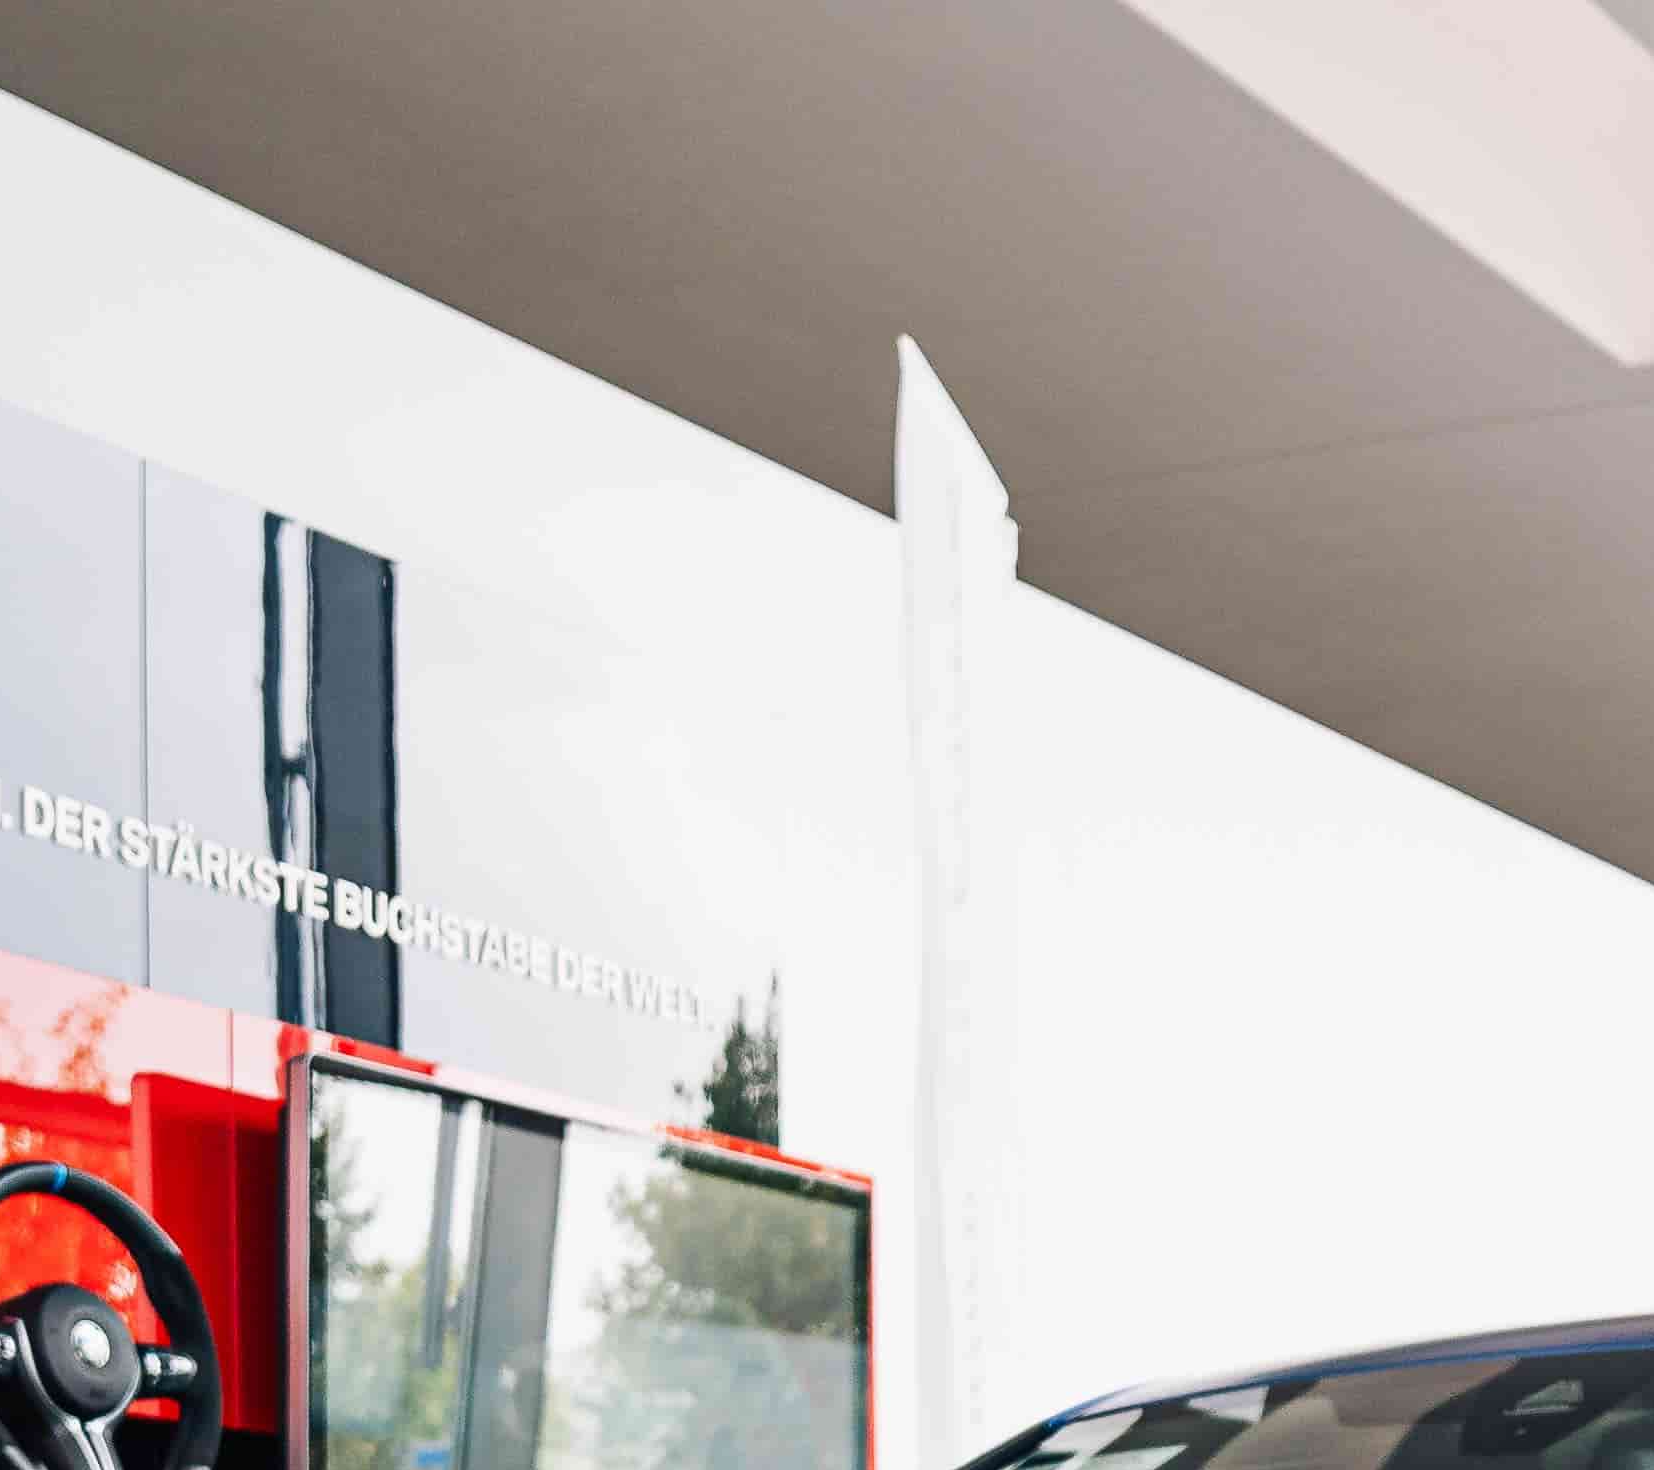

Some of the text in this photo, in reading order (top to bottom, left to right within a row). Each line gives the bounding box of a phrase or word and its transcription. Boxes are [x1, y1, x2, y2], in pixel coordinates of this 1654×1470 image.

[21, 785, 114, 858] DER
[118, 816, 330, 921] STÄRKSTE
[333, 878, 551, 984] BUCHSTABE
[554, 944, 625, 1004] DER
